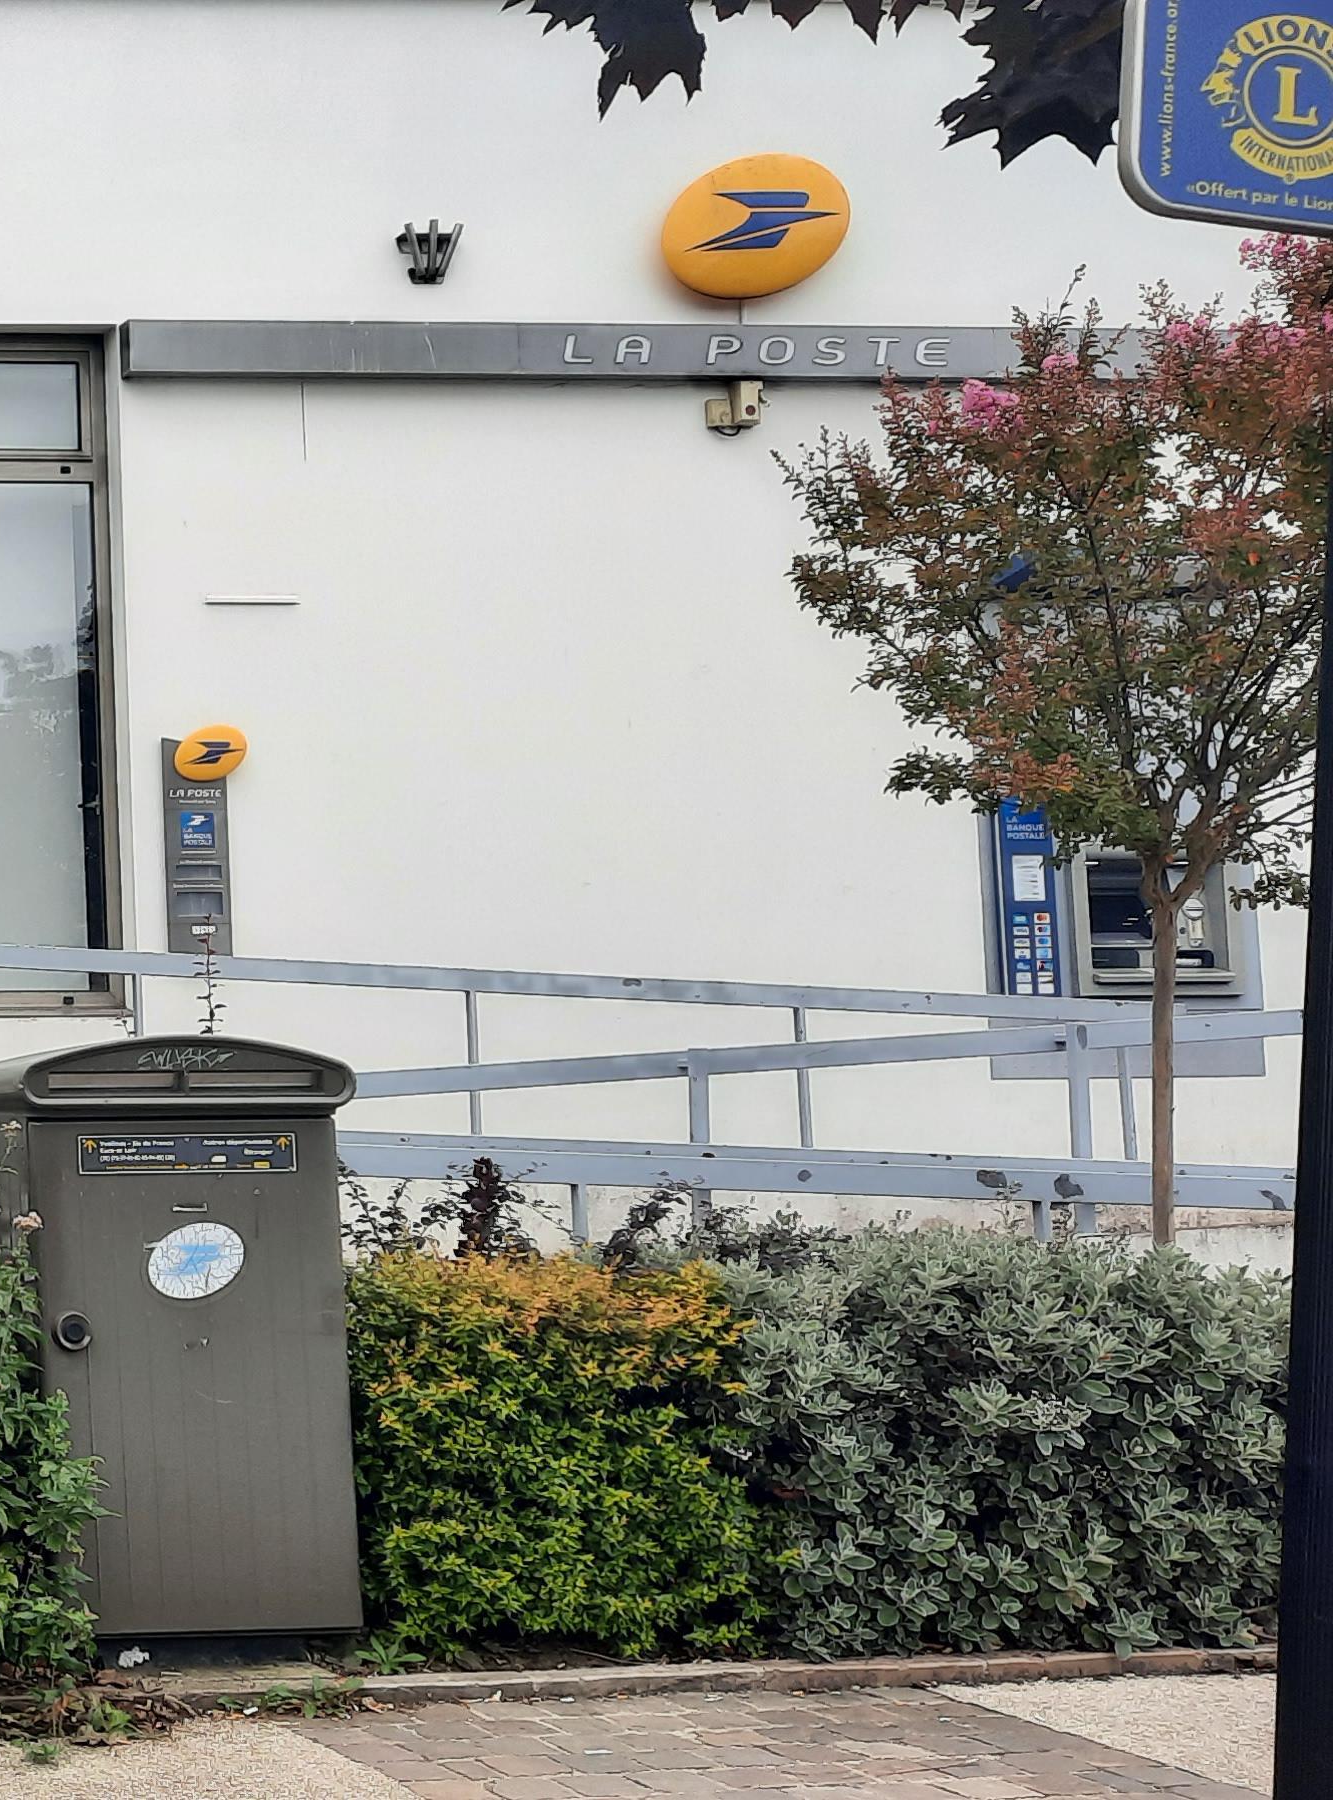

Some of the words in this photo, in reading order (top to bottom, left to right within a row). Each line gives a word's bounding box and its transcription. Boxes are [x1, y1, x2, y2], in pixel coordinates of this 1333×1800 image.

[1243, 19, 1333, 61] LION
[1273, 65, 1318, 127] L
[1252, 192, 1278, 205] par
[1285, 192, 1298, 206] le
[562, 334, 652, 365] LA
[705, 335, 951, 367] POSTE
[169, 789, 184, 797] LA
[187, 789, 222, 797] POSTE
[1005, 815, 1018, 823] LA
[1006, 823, 1045, 831] BANQUE
[1006, 832, 1046, 840] POSTALE
